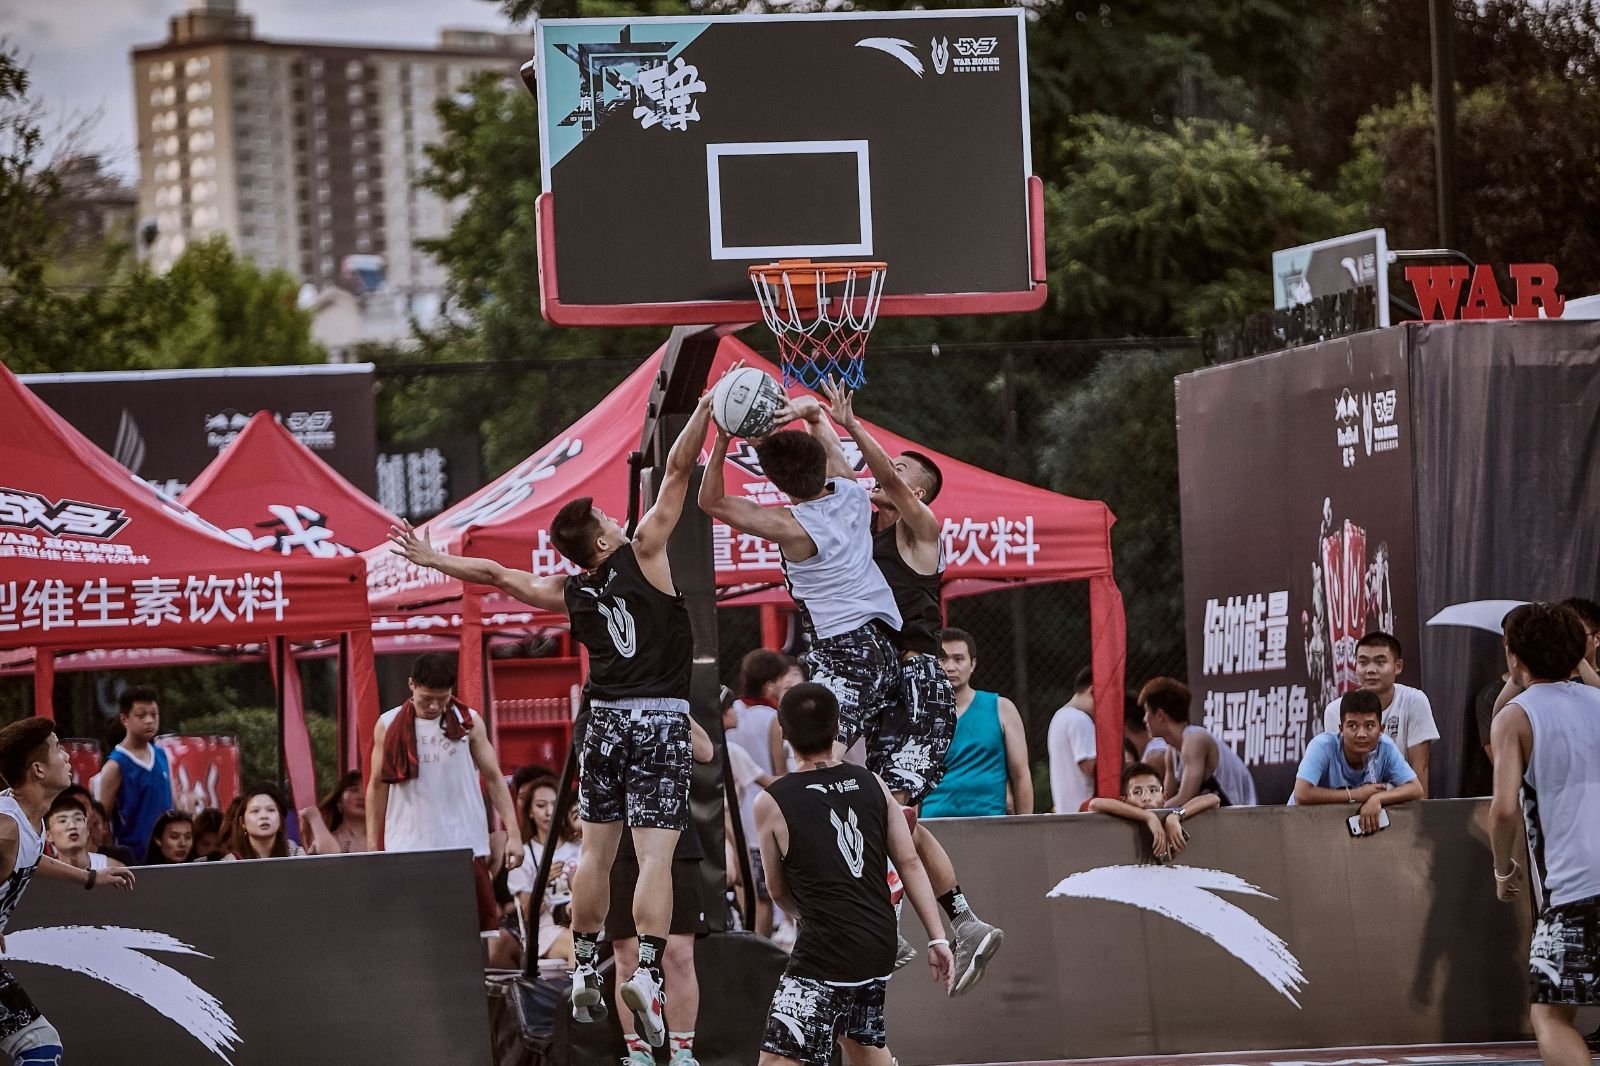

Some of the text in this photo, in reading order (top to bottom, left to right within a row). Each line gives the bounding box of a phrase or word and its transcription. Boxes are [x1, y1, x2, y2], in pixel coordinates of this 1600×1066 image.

[953, 57, 1000, 66] WAR HORSE
[1405, 263, 1566, 322] WAR
[43, 536, 134, 556] HORSE
[1202, 590, 1289, 676] 你的能量
